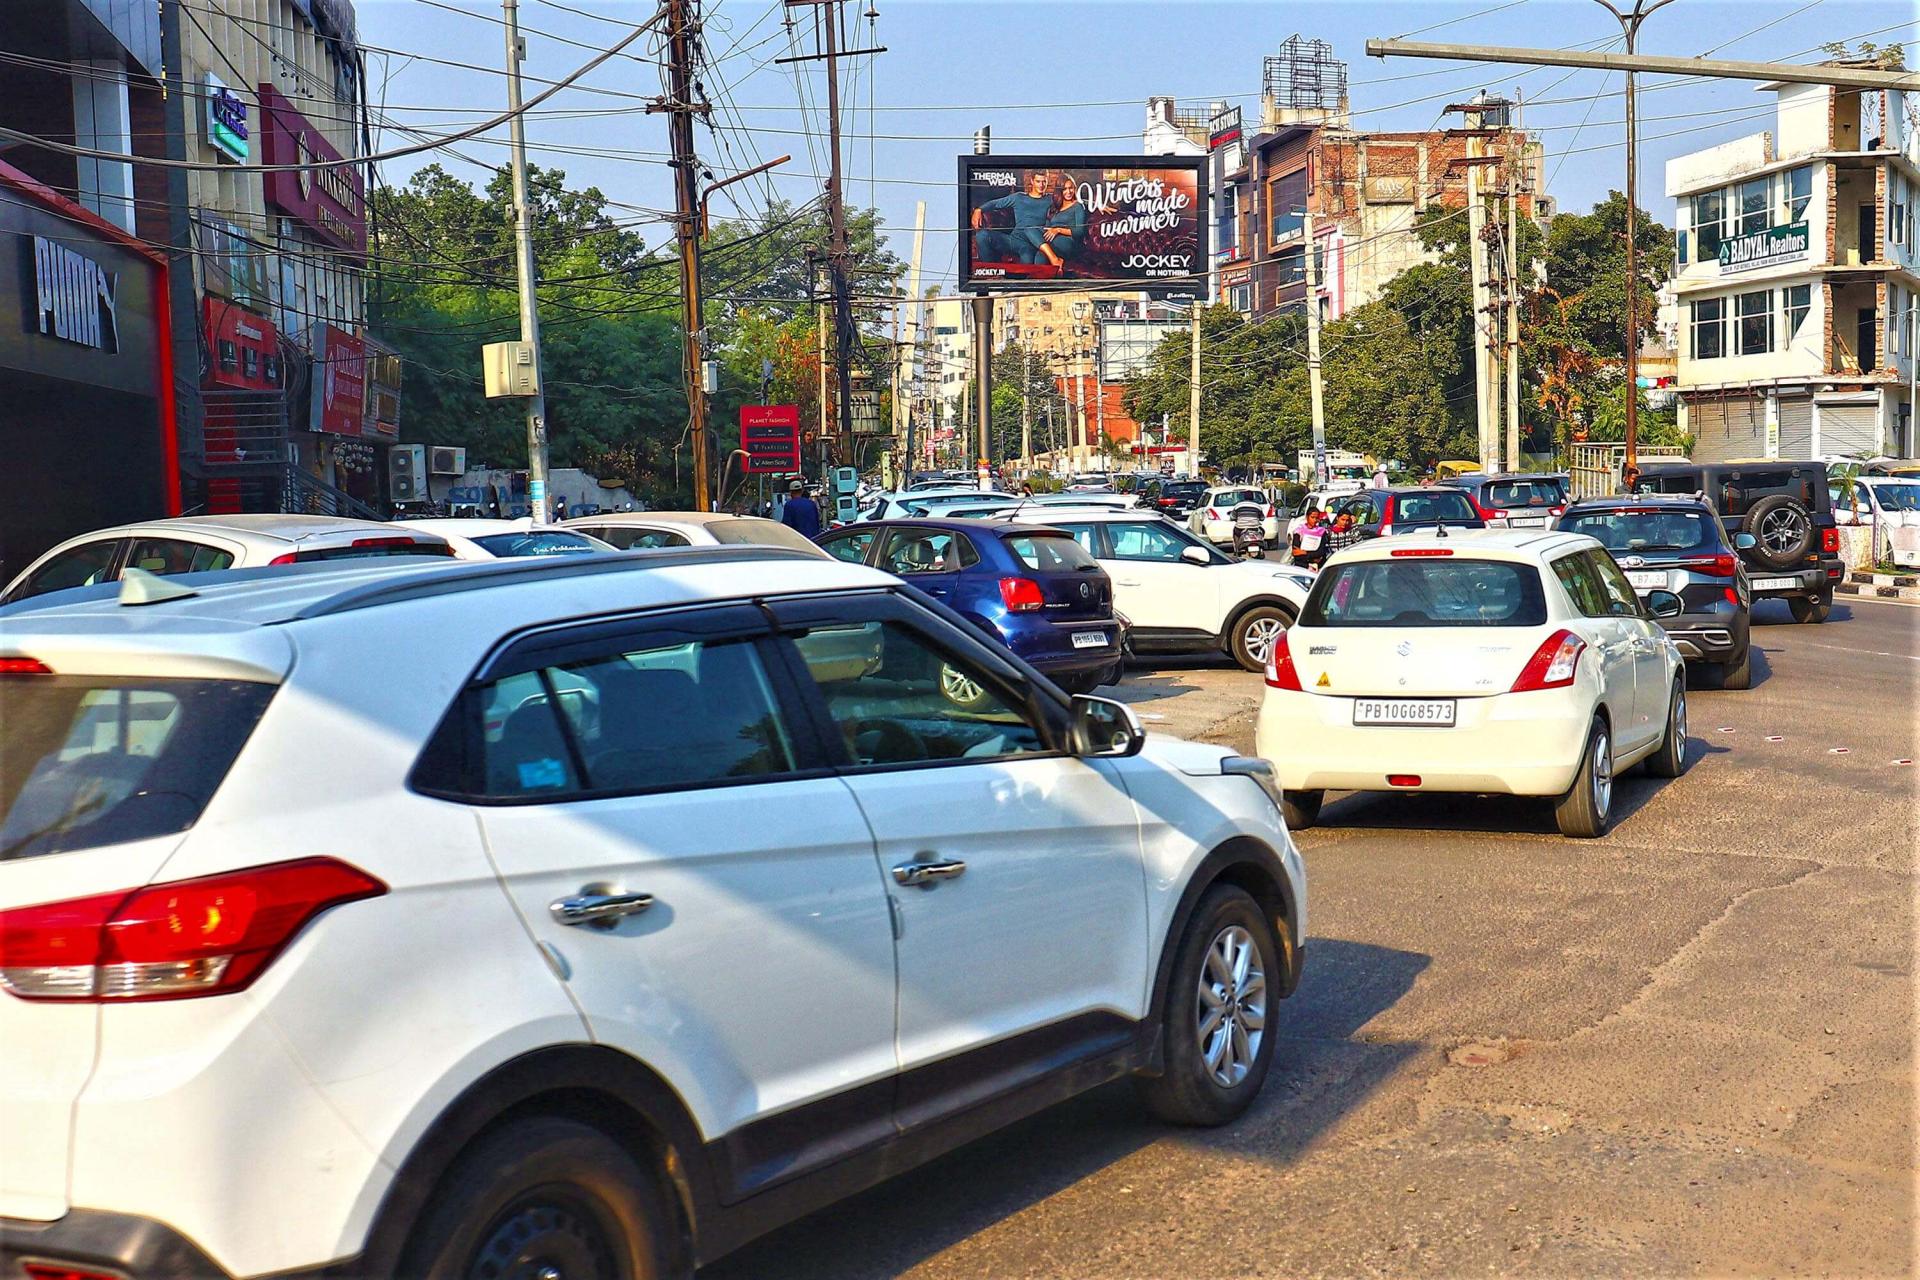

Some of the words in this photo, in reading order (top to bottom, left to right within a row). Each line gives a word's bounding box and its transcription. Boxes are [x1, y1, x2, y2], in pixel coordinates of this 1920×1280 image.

[1220, 108, 1239, 131] STORE
[973, 172, 1016, 180] THERMAL
[1076, 176, 1165, 215] Winters
[1135, 187, 1190, 216] made
[1100, 211, 1180, 238] warmer
[1121, 254, 1191, 268] JOCKEY
[1731, 233, 1770, 264] BADYAL
[1770, 232, 1805, 256] Realtors
[34, 234, 101, 349] PUMA
[1365, 703, 1452, 719] PB10GG8573
